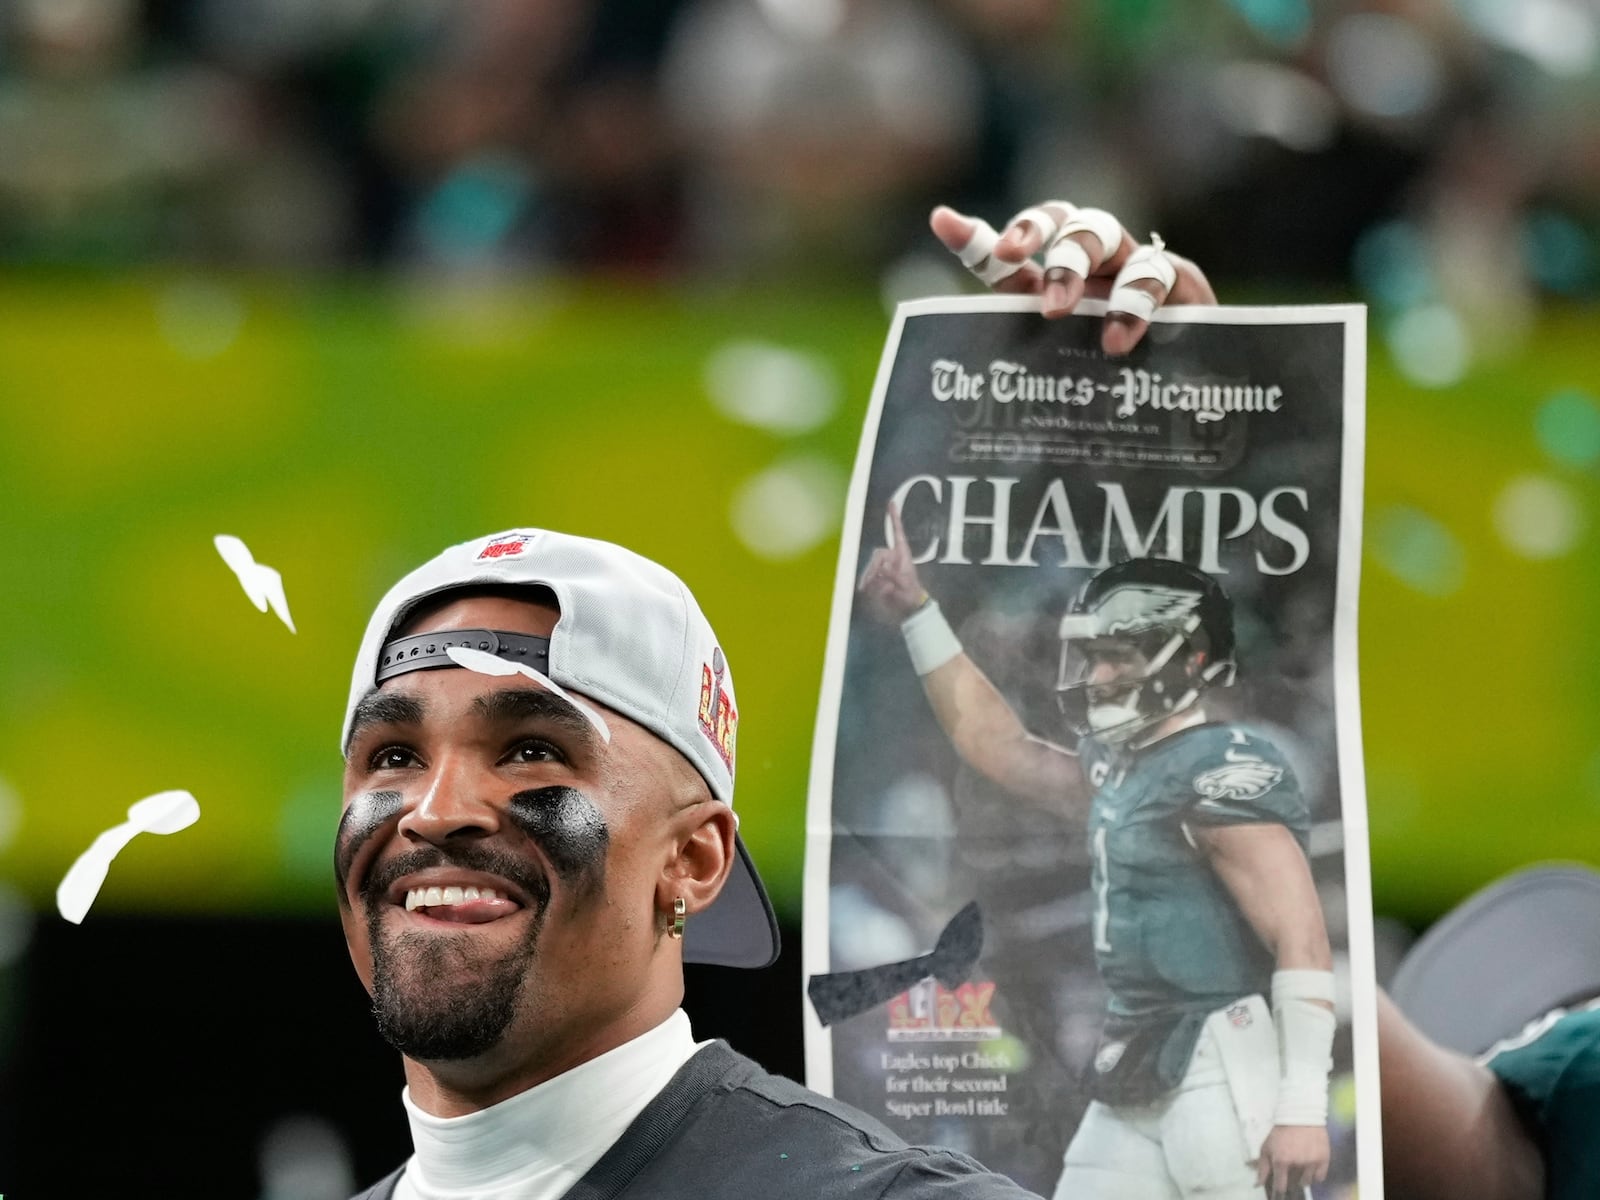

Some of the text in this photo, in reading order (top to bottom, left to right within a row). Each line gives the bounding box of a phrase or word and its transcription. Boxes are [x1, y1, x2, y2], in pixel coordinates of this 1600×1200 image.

[931, 359, 985, 402] The
[884, 474, 1311, 577] CHAMPS
[881, 1051, 1011, 1073] Eagles top Chiefs
[886, 1073, 1007, 1093] for their second
[885, 1098, 1008, 1120] Super Bowl title
